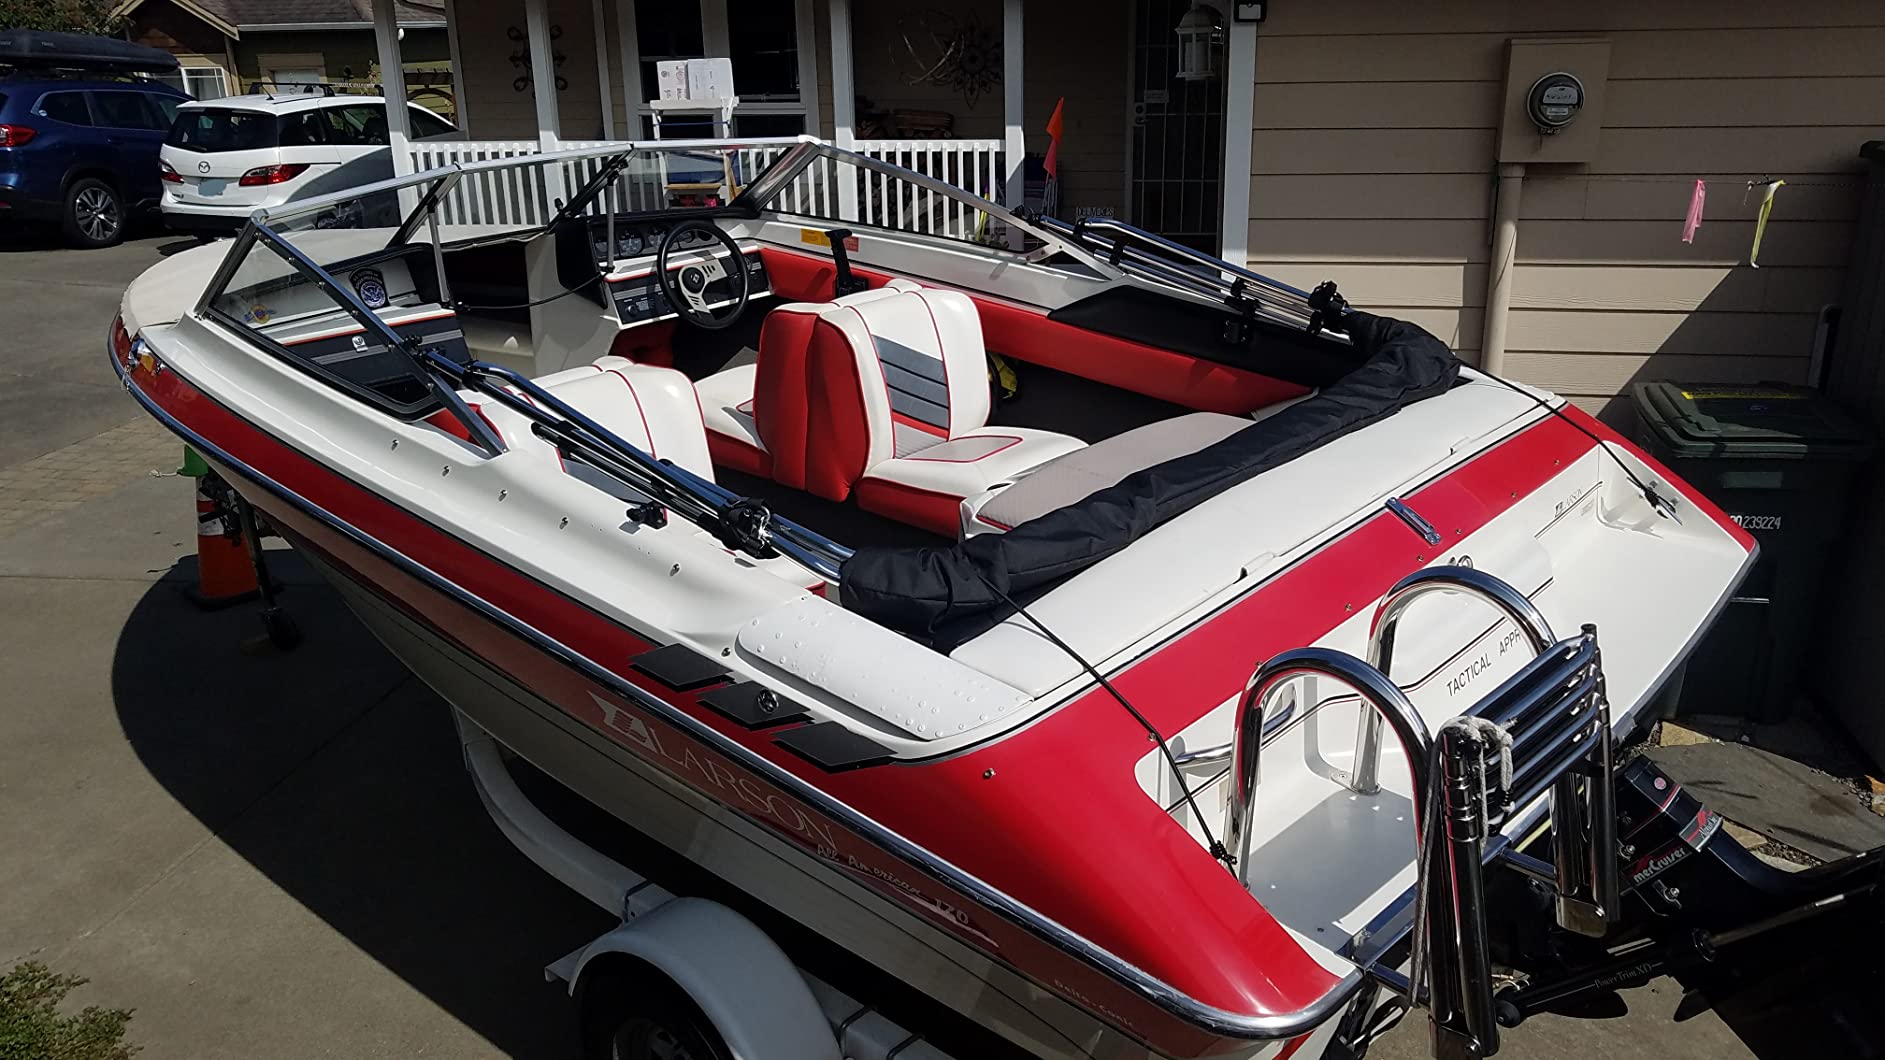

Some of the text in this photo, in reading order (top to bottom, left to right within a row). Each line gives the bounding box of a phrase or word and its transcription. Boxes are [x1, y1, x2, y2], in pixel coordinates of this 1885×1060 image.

[1446, 653, 1492, 696] TACTICAL
[650, 727, 838, 850] LARSON
[817, 843, 840, 861] All
[934, 897, 969, 924] 170
[1633, 847, 1687, 883] merCruiser
